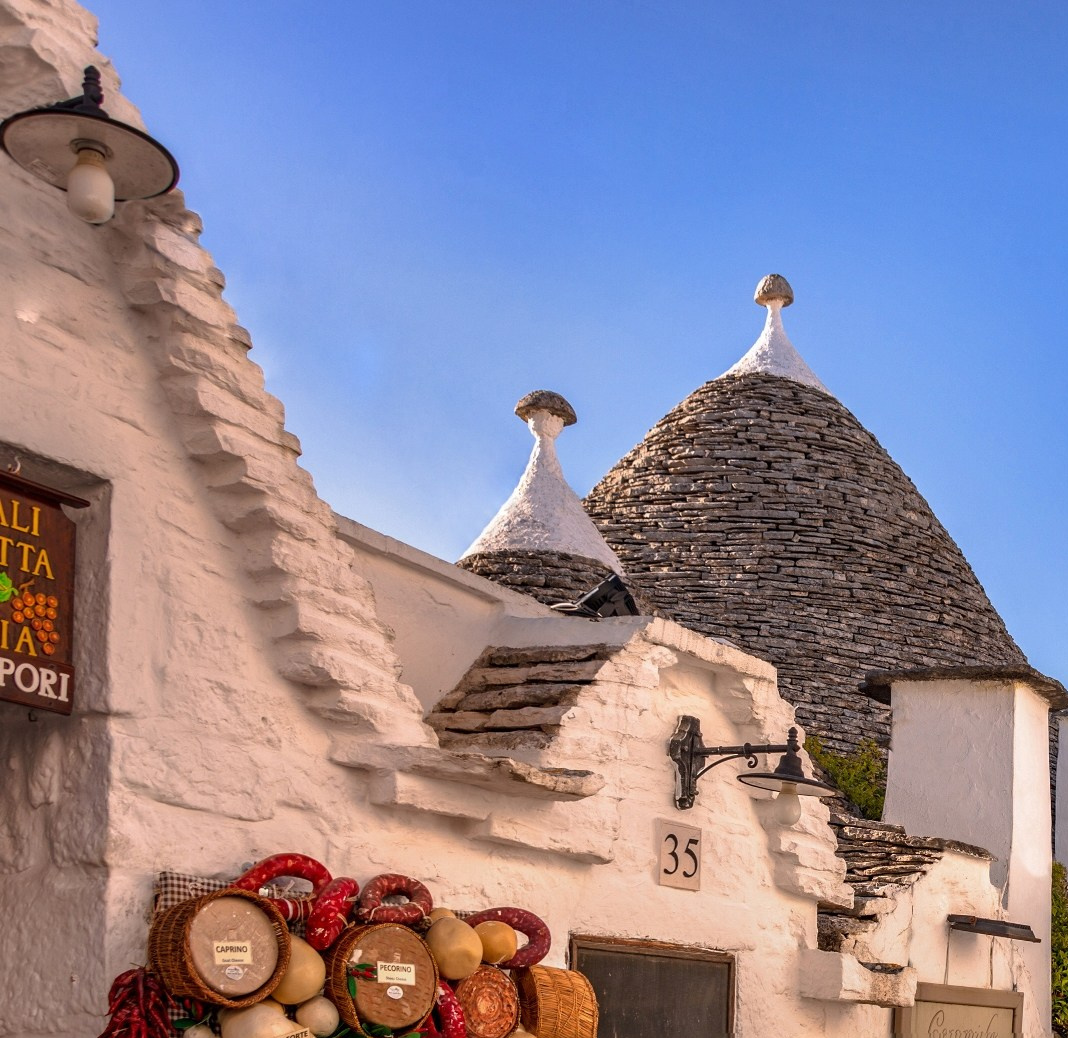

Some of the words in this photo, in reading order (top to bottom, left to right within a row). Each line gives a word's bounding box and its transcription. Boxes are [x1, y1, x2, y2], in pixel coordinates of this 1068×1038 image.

[0, 656, 70, 702] PORI
[663, 833, 699, 878] 35
[380, 964, 412, 973] PECORINO
